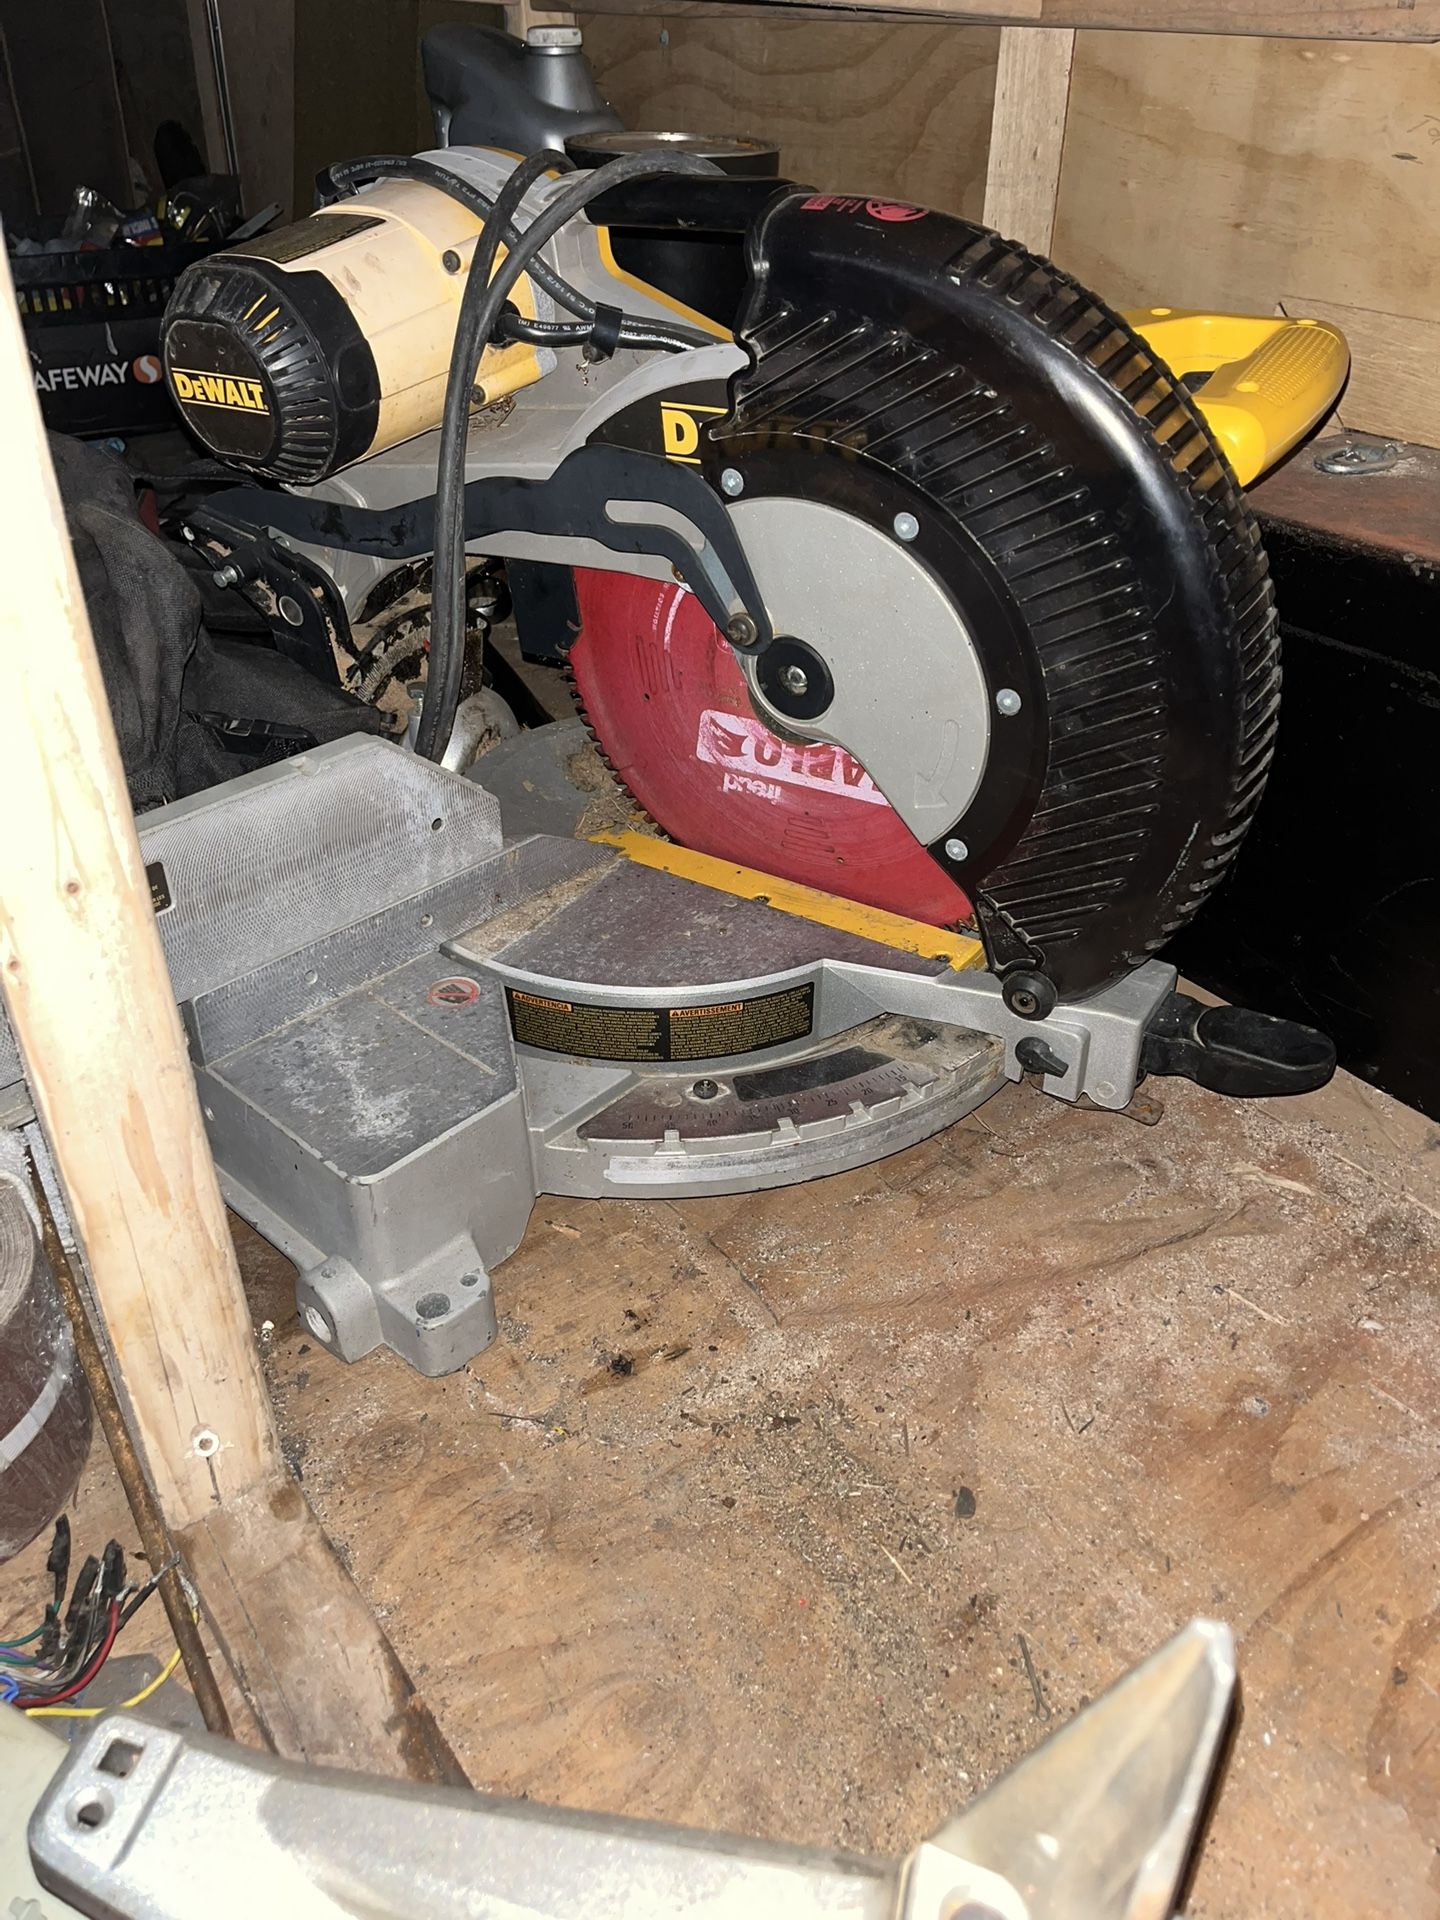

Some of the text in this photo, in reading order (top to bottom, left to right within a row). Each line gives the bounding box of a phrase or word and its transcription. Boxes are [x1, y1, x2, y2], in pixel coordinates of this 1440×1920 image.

[34, 361, 129, 392] AFEWAY
[754, 743, 875, 791] ABLO
[520, 993, 570, 1011] ADVERTENCIA
[680, 1003, 743, 1018] AVERTISSEMENT
